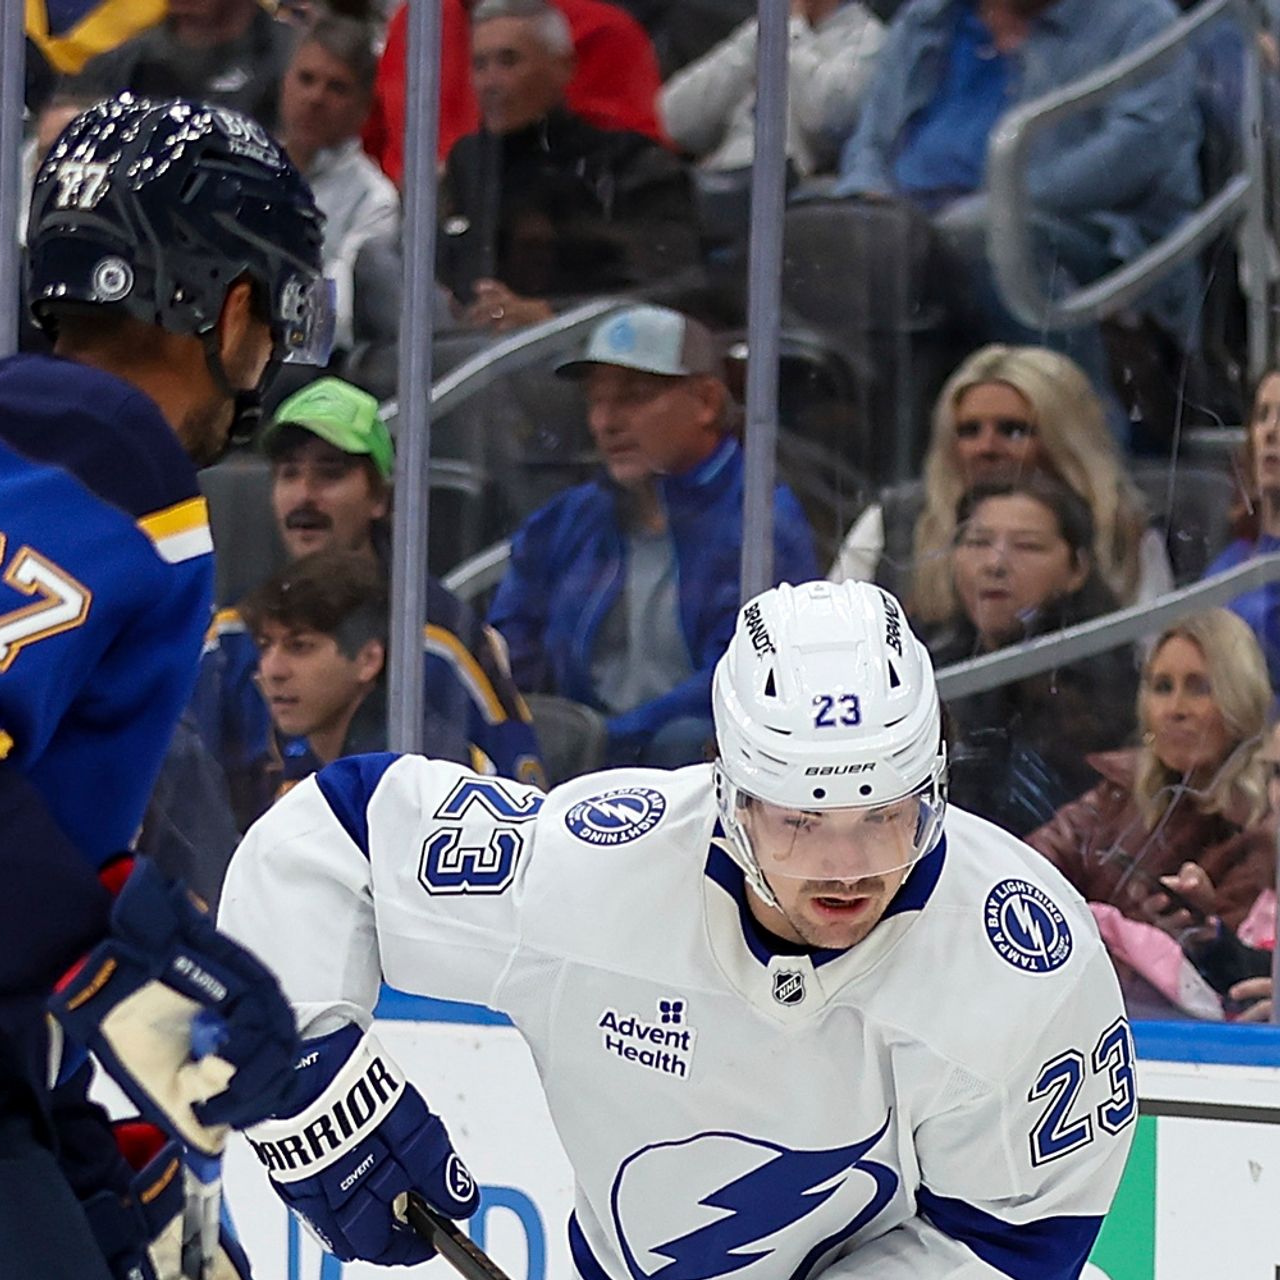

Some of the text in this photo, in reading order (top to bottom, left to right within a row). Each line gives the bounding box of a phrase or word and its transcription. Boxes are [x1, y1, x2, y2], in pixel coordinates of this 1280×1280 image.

[57, 161, 108, 210] 77
[812, 693, 862, 729] 23
[805, 762, 877, 776] BAUER
[418, 776, 547, 896] 23
[579, 811, 661, 844] LIGHTNING
[987, 897, 1001, 929] BAY
[995, 881, 1064, 924] LIGHTNING
[993, 931, 1039, 971] TAMPA
[599, 1011, 690, 1052] Advent
[605, 1034, 686, 1077] Health
[1027, 1016, 1138, 1168] 23
[340, 1154, 376, 1192] COVERT
